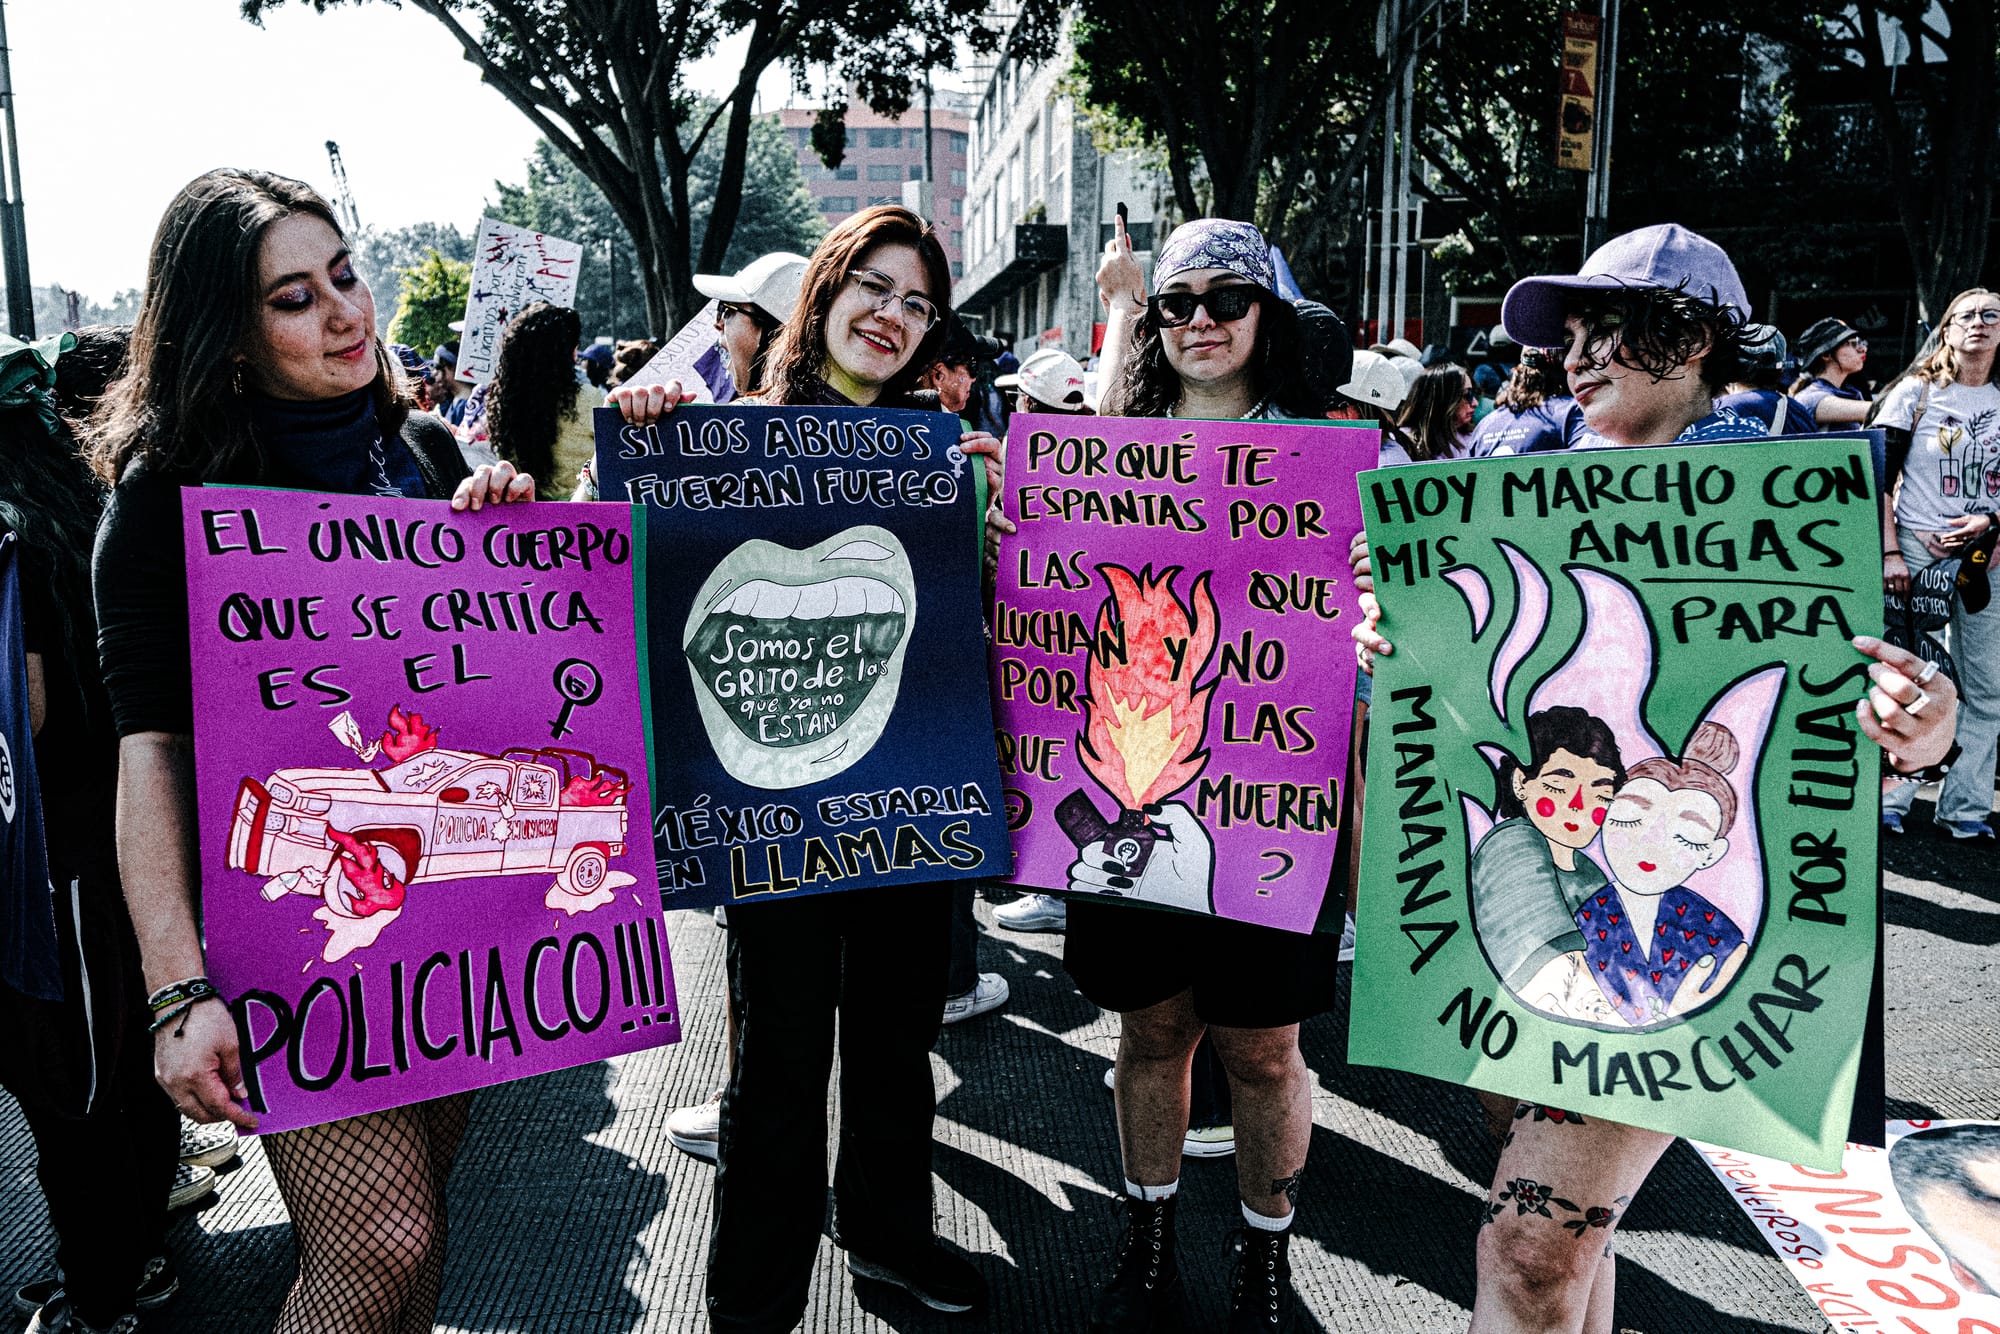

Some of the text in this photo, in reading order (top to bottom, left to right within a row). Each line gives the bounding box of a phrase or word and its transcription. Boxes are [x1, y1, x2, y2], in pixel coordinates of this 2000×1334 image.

[618, 416, 932, 460] SI LOS ABUSOS
[1216, 444, 1278, 487] TE
[624, 465, 958, 511] FUERAN FUEGO
[1017, 484, 1330, 540] ESPANTAS POR
[1370, 454, 1876, 526] HOY MARCHO CON
[201, 503, 630, 571] EL ÚNICO CUERPO
[1376, 518, 1846, 587] MIS AMIGAS
[1017, 548, 1341, 618] LAS QUE
[218, 591, 329, 642] QUE
[351, 593, 402, 640] SE
[709, 623, 863, 665] Somos el
[1671, 595, 1857, 646] PARA
[257, 643, 492, 710] ES EL
[714, 657, 889, 698] GRITO de las
[1163, 636, 1189, 682] Y
[1218, 630, 1289, 686] NO
[740, 693, 844, 721] que ya no
[1000, 658, 1318, 756] POR LAS
[1789, 660, 1872, 813] ELLAS
[817, 782, 993, 827] ESTARIA
[1197, 773, 1340, 834] MUEREN
[730, 819, 985, 900] LLAMAS
[1255, 848, 1296, 897] ?
[1787, 827, 1849, 928] POR
[1437, 987, 1520, 1062] NO
[1551, 951, 1830, 1102] MARCHAR
